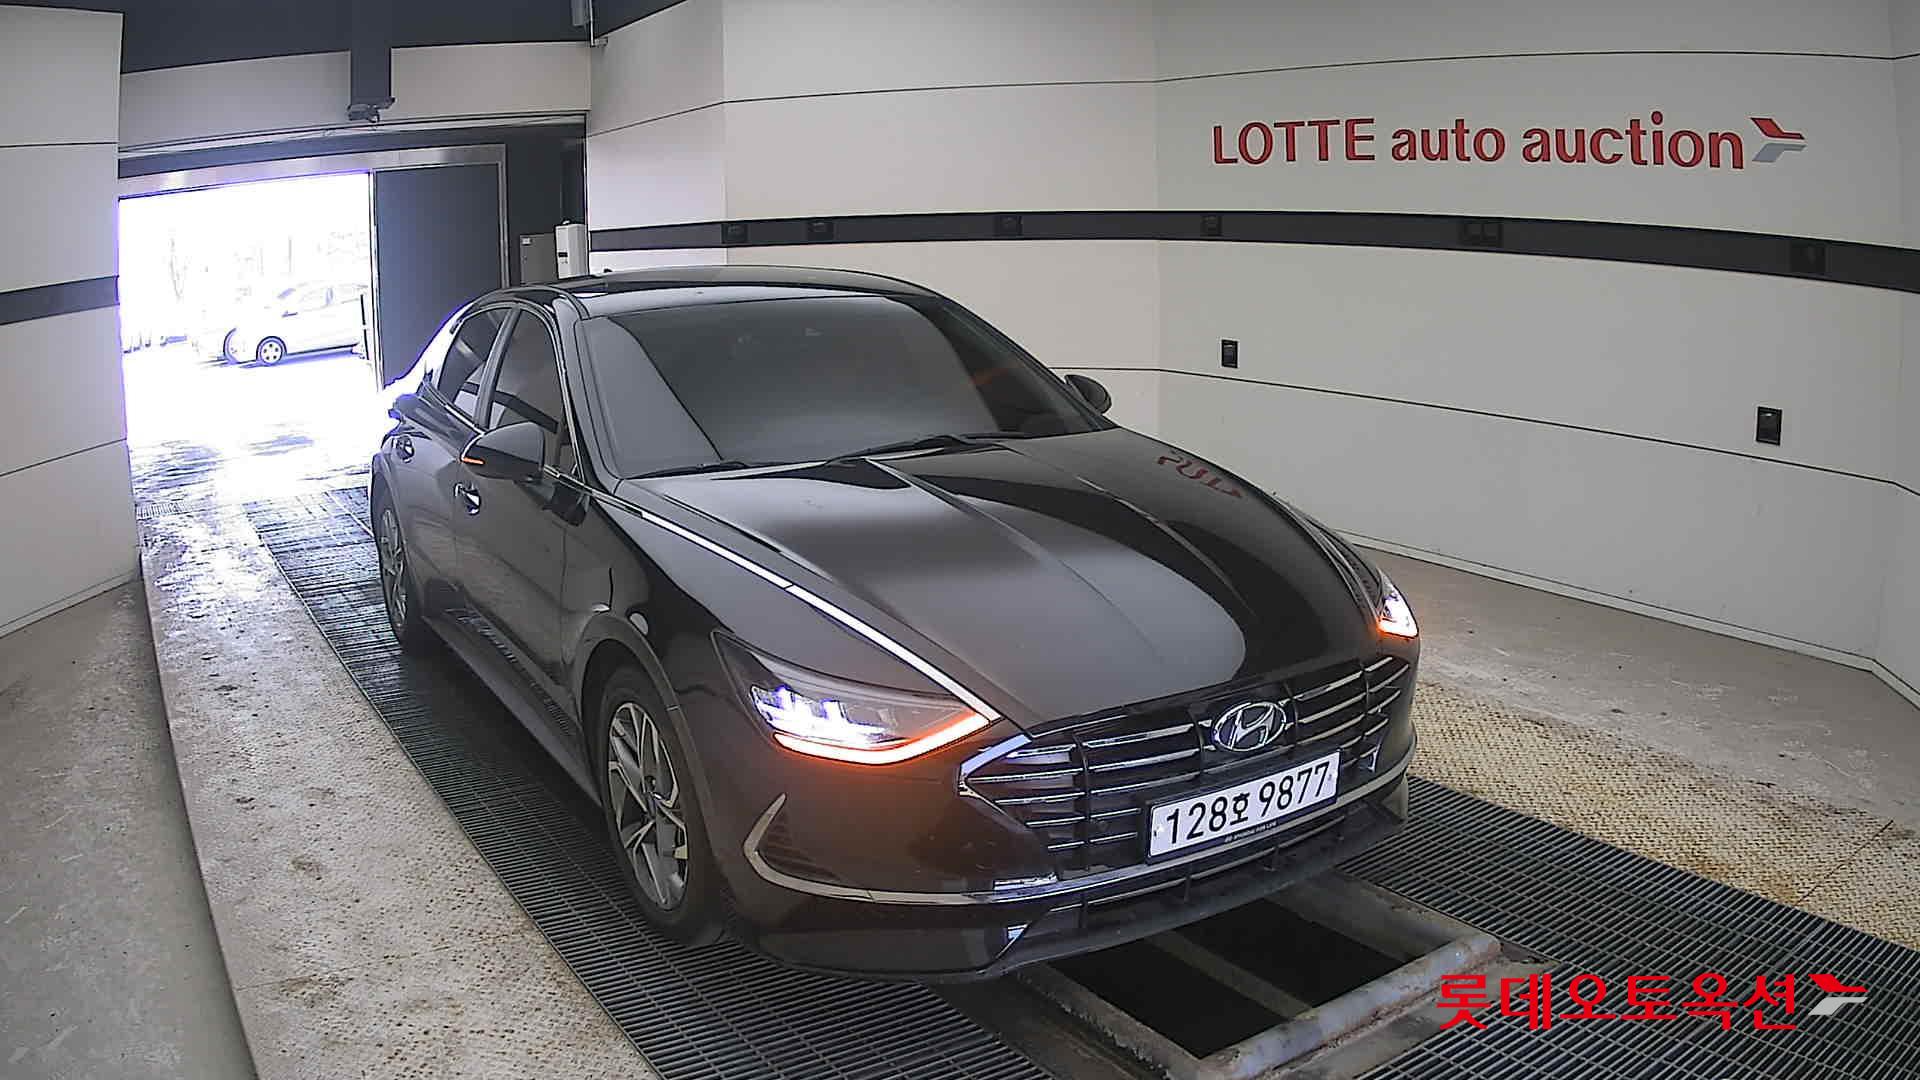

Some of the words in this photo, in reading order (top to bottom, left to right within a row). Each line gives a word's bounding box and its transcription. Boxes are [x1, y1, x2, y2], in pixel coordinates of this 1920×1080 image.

[1212, 118, 1375, 165] LOTTE
[1392, 118, 1505, 162] auto
[1522, 111, 1744, 169] auction
[1166, 793, 1250, 844] 128호
[1259, 761, 1330, 817] 9877
